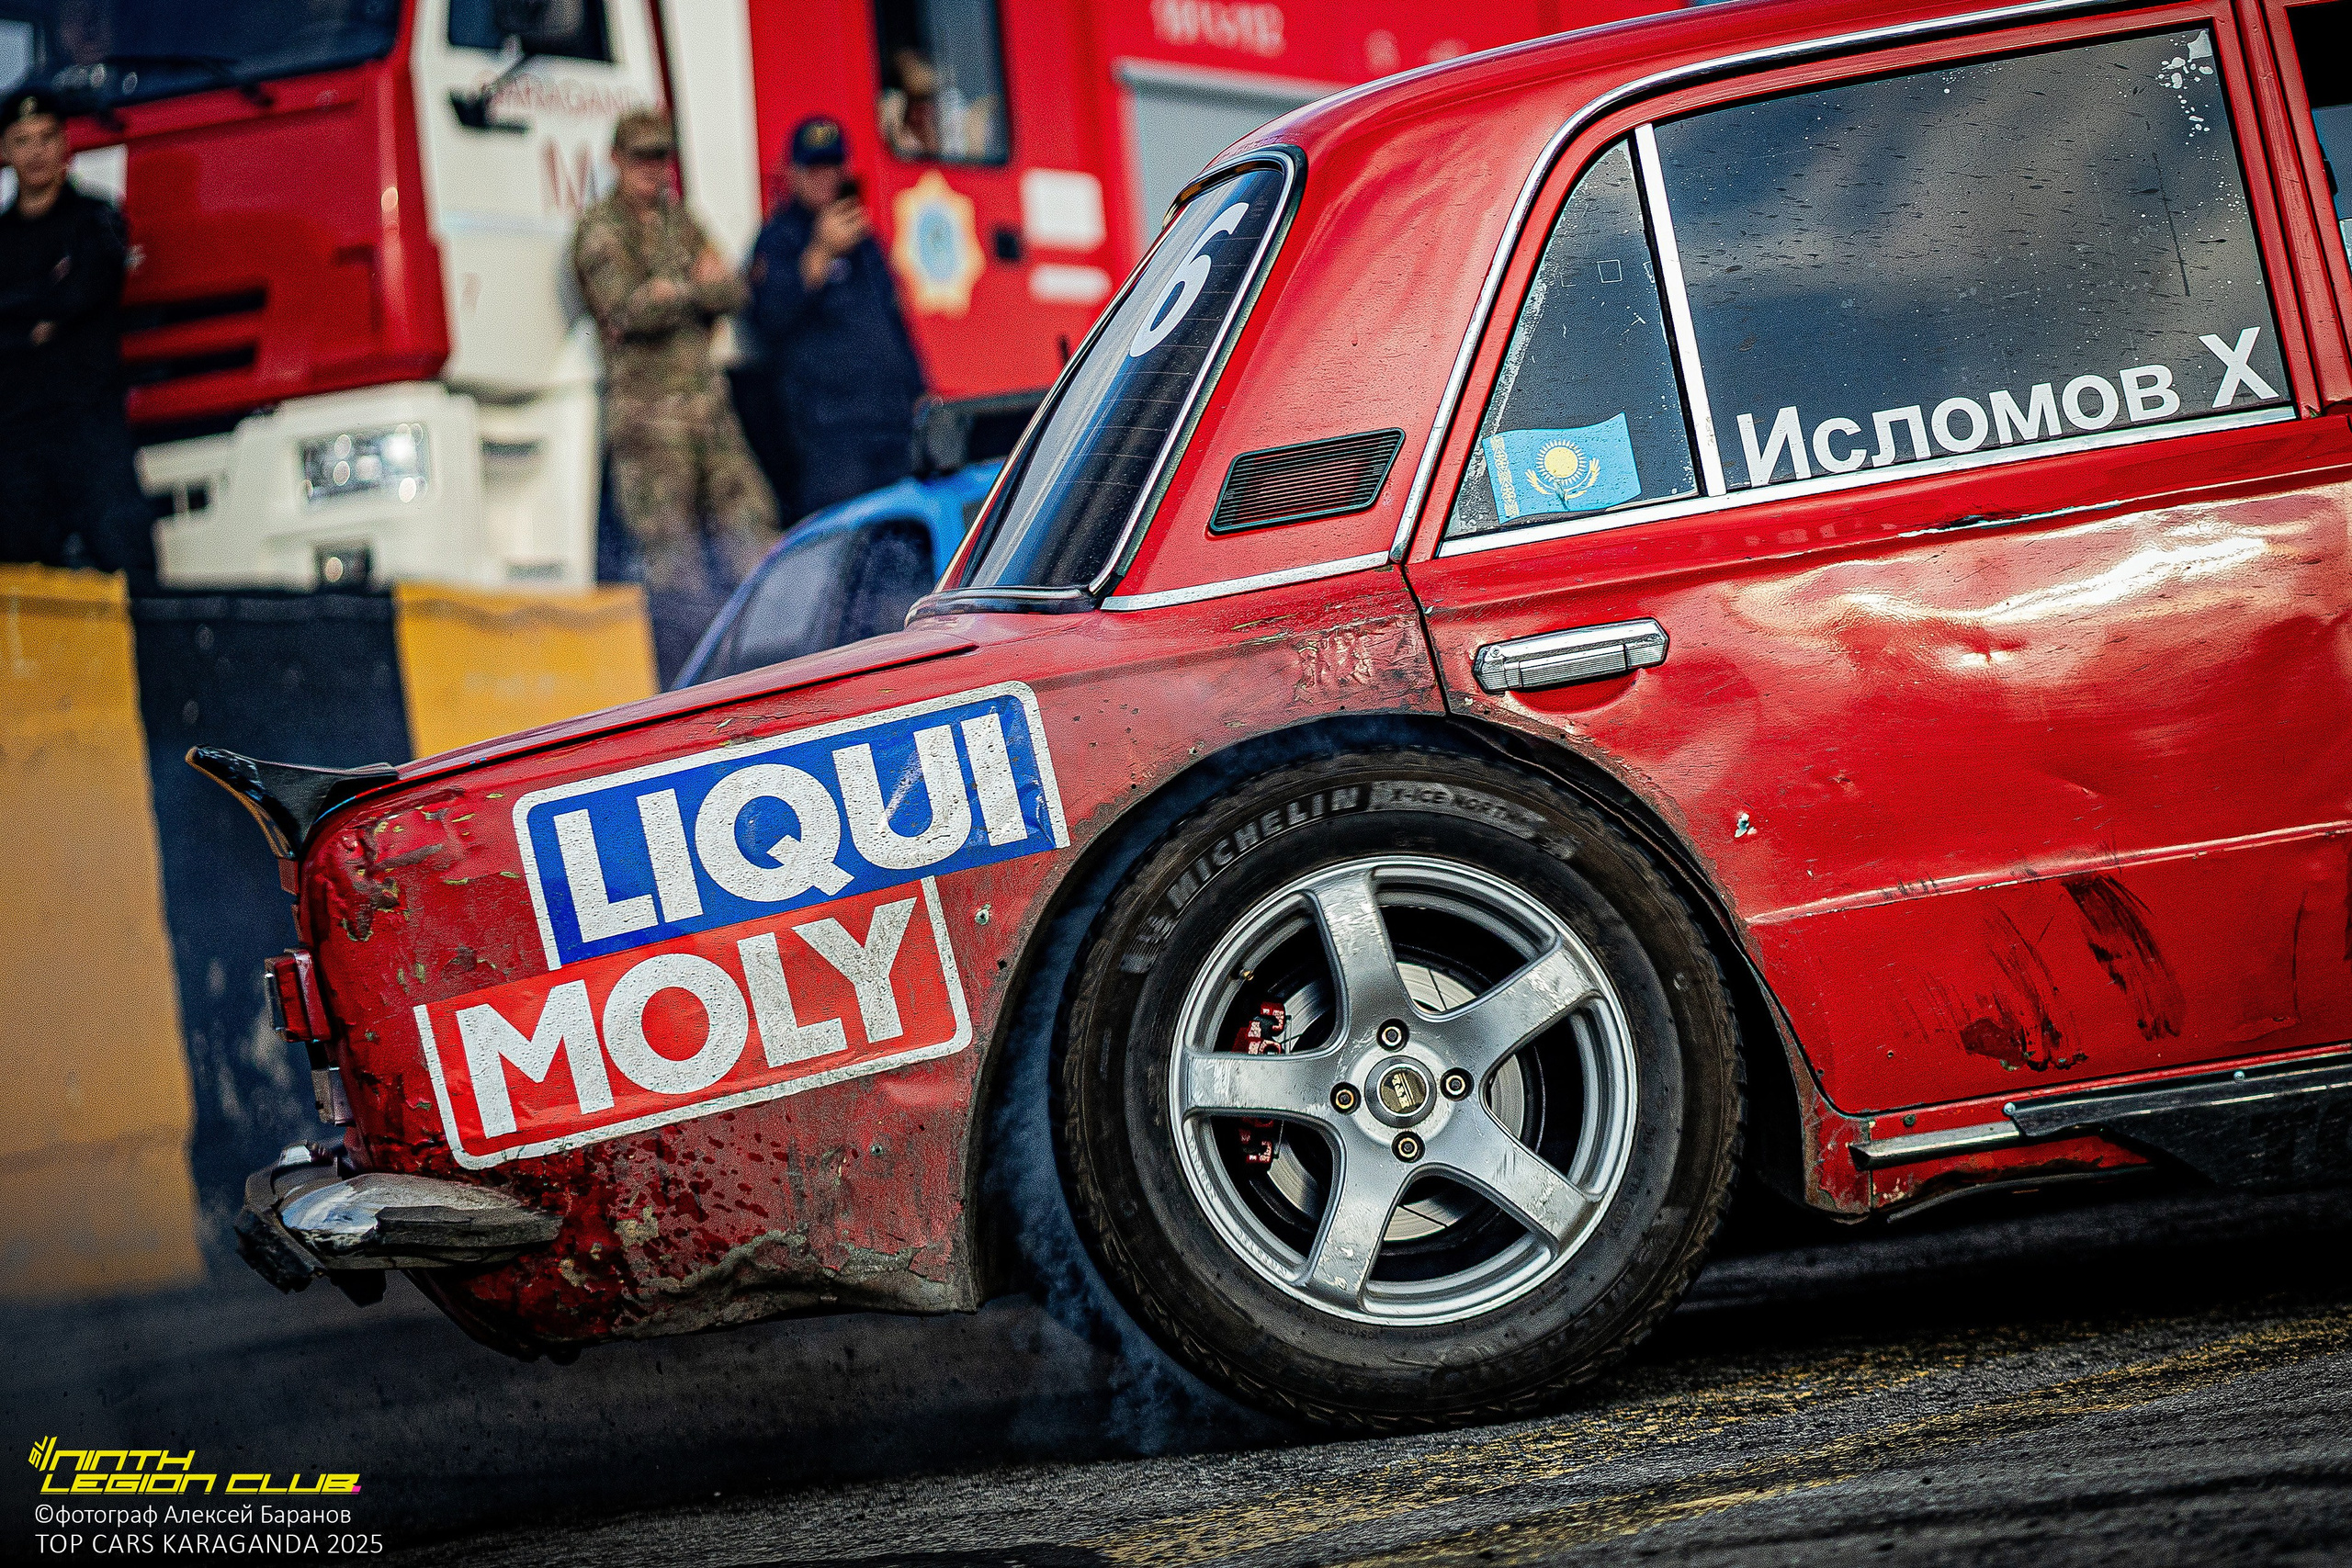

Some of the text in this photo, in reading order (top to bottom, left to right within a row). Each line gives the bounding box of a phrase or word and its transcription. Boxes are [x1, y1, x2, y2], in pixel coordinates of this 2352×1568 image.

[1129, 202, 1250, 357] 6
[1737, 364, 2181, 488] Исломов
[554, 713, 1027, 943] LIQUI
[1166, 785, 1360, 911] MICHELIN
[456, 897, 918, 1138] MOLY
